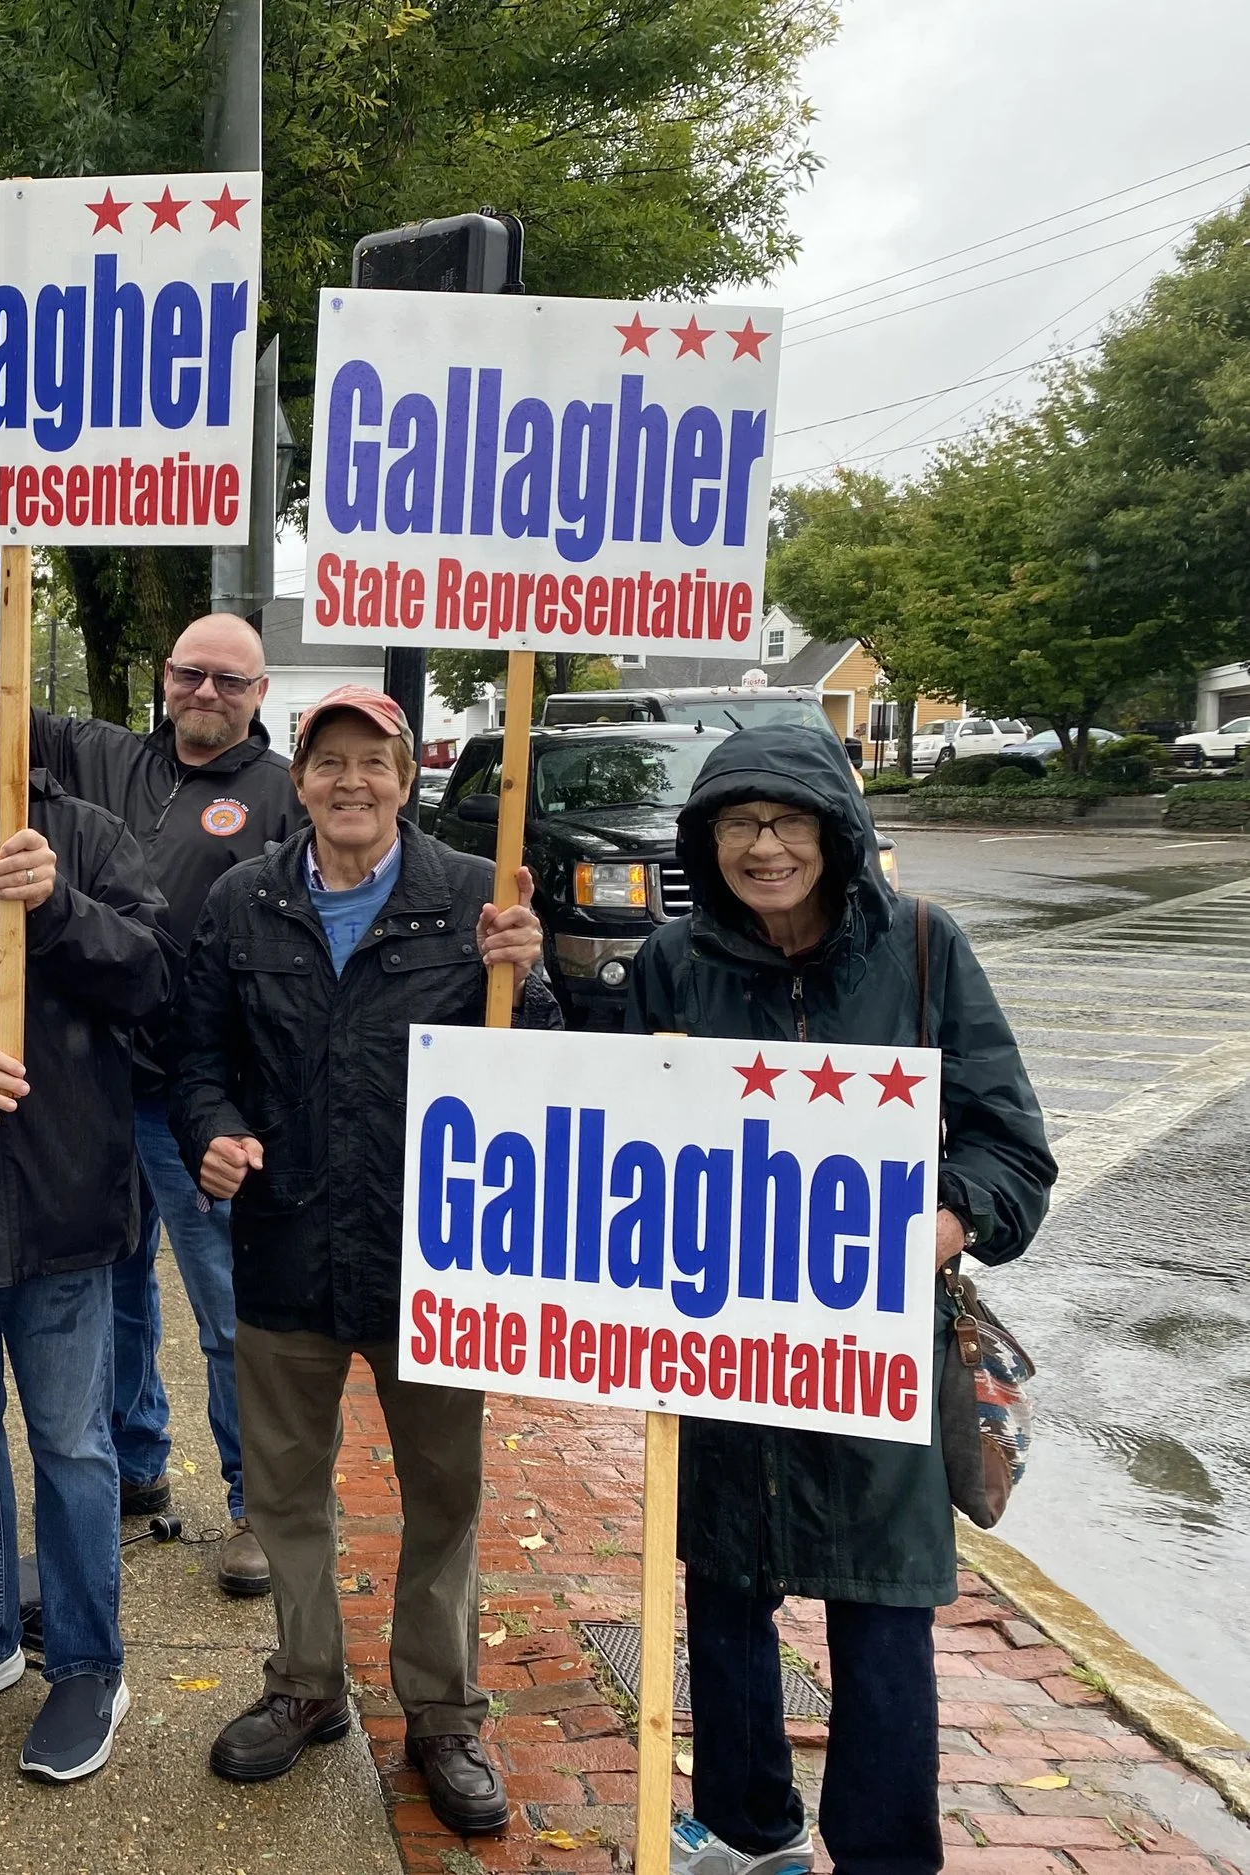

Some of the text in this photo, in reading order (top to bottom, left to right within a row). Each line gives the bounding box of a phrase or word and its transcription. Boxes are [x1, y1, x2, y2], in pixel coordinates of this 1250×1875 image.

[326, 360, 766, 563] Gallagher
[315, 553, 752, 642] State Representative
[417, 1095, 925, 1320] Gallagher
[410, 1288, 918, 1423] State Representative
